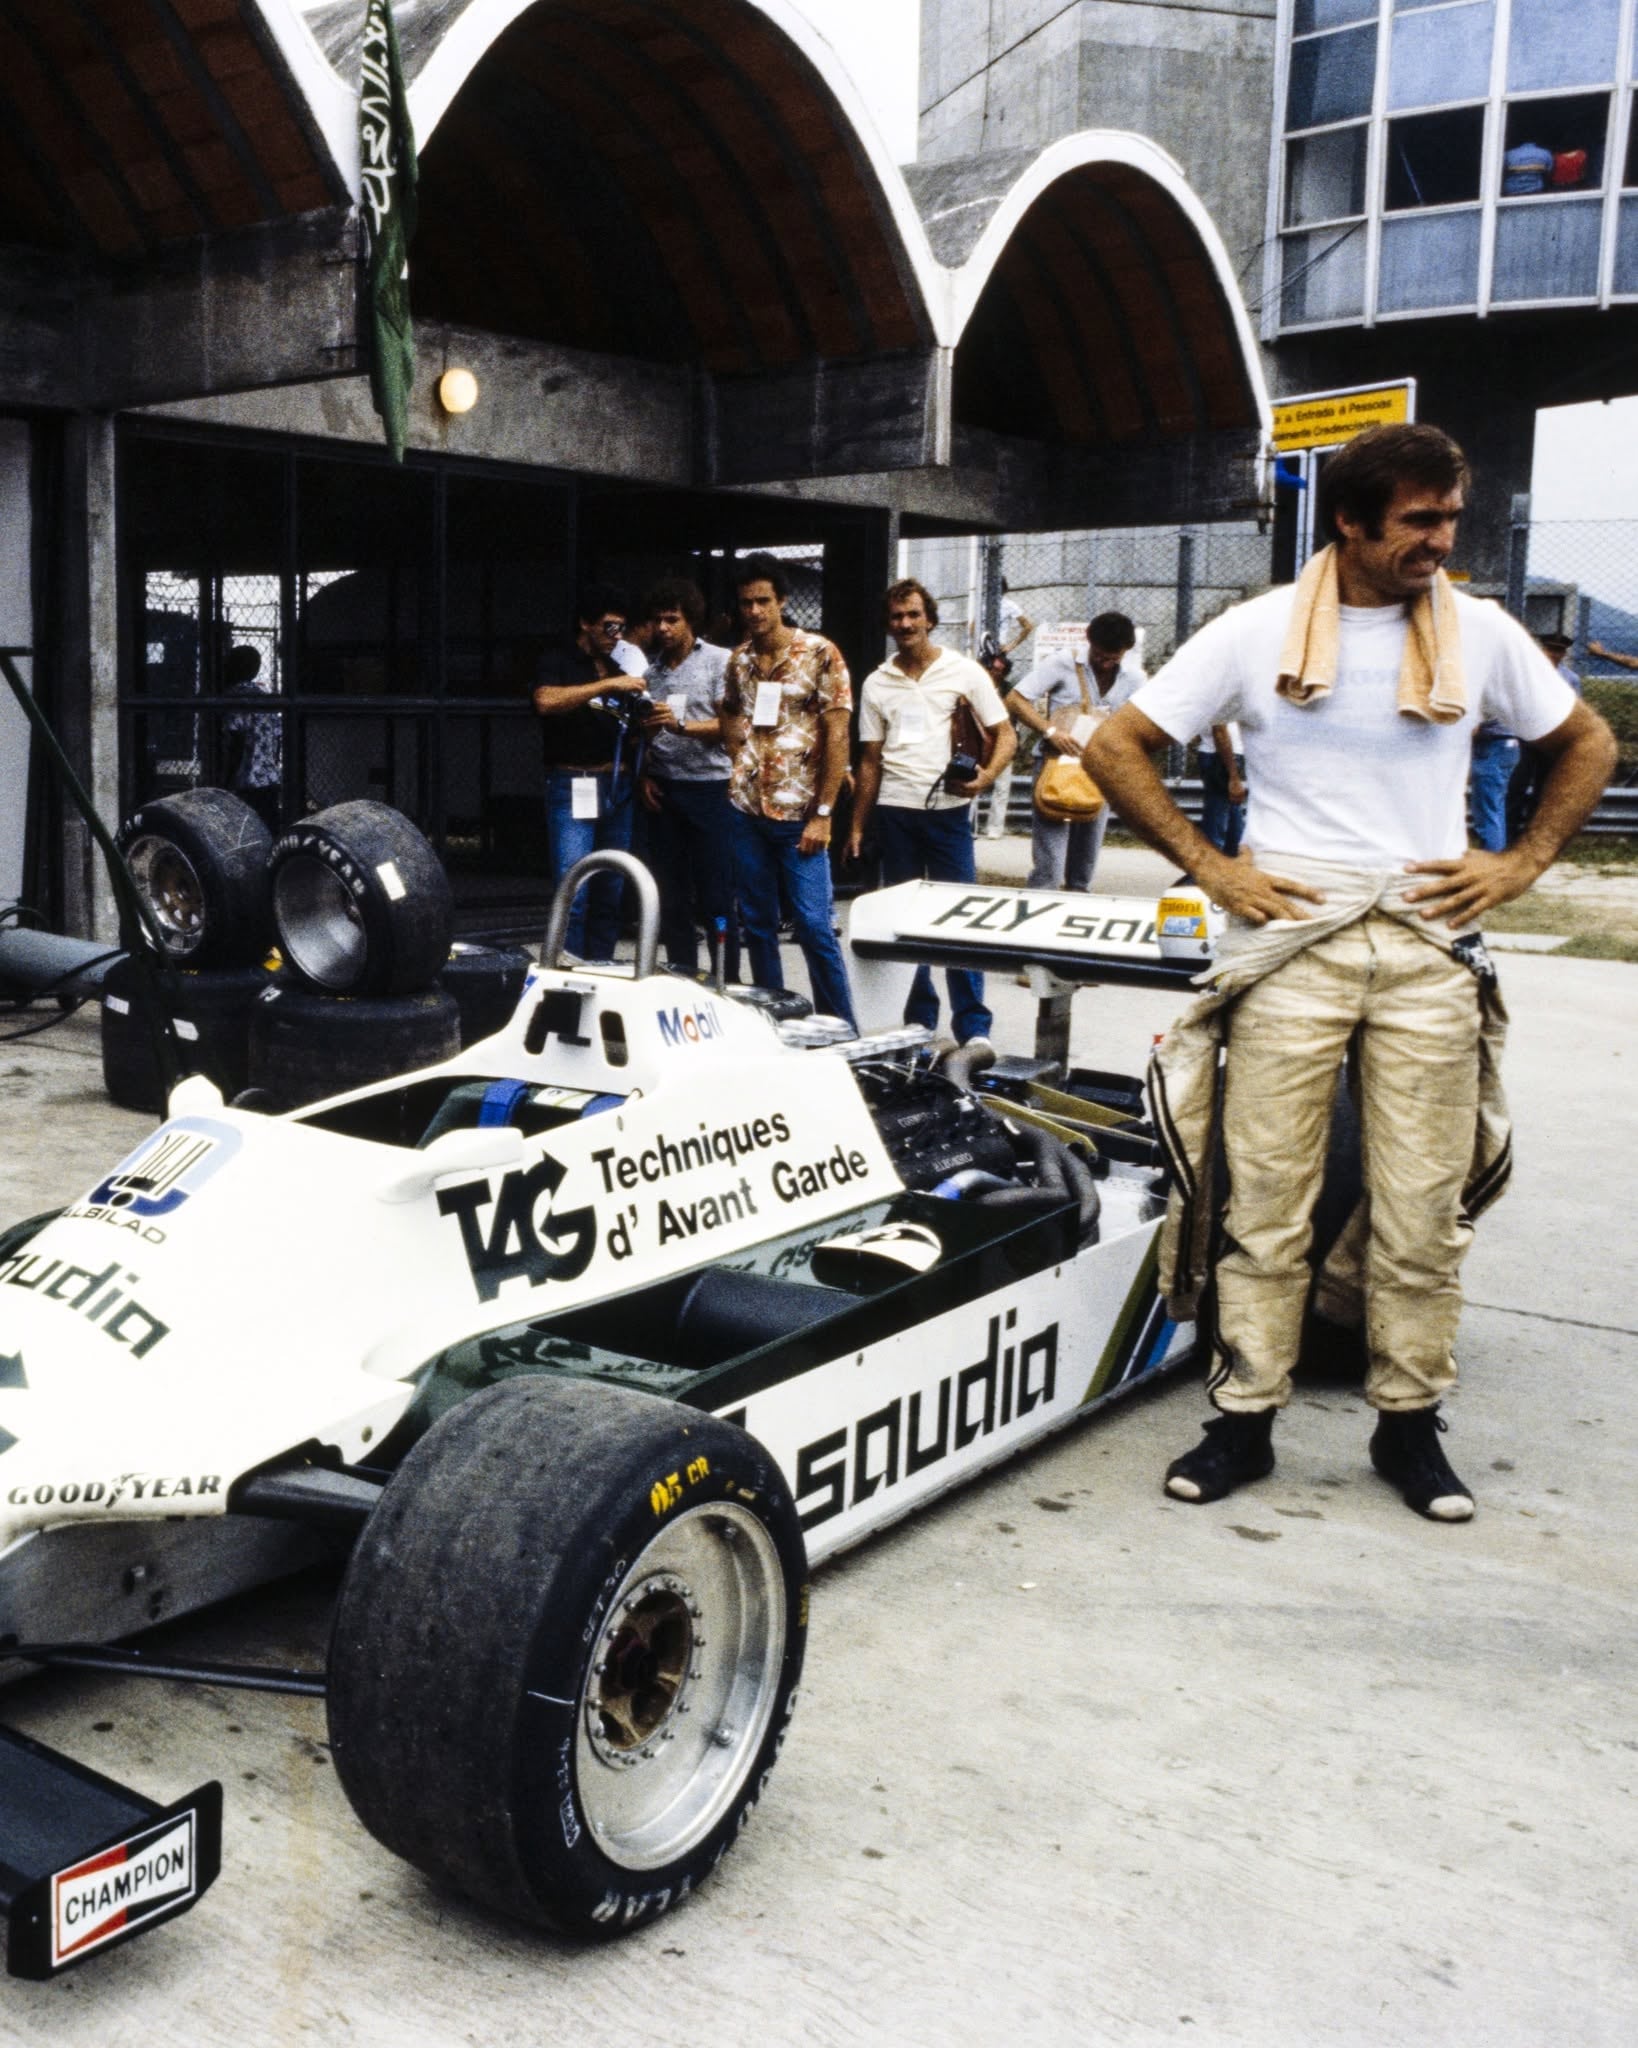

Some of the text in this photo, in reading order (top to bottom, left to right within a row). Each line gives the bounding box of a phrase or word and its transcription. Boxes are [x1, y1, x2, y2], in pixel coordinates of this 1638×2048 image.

[1296, 406, 1335, 422] Entrada
[1348, 398, 1393, 413] Pessoas
[929, 895, 1066, 933] FLY
[656, 1001, 725, 1048] Mobil
[591, 1112, 791, 1194] Techniques
[436, 1150, 597, 1304] TAG
[657, 1177, 759, 1246] Avant
[771, 1144, 869, 1203] Garde
[796, 1307, 1060, 1533] saudia
[64, 1844, 185, 1925] CHAMPION
